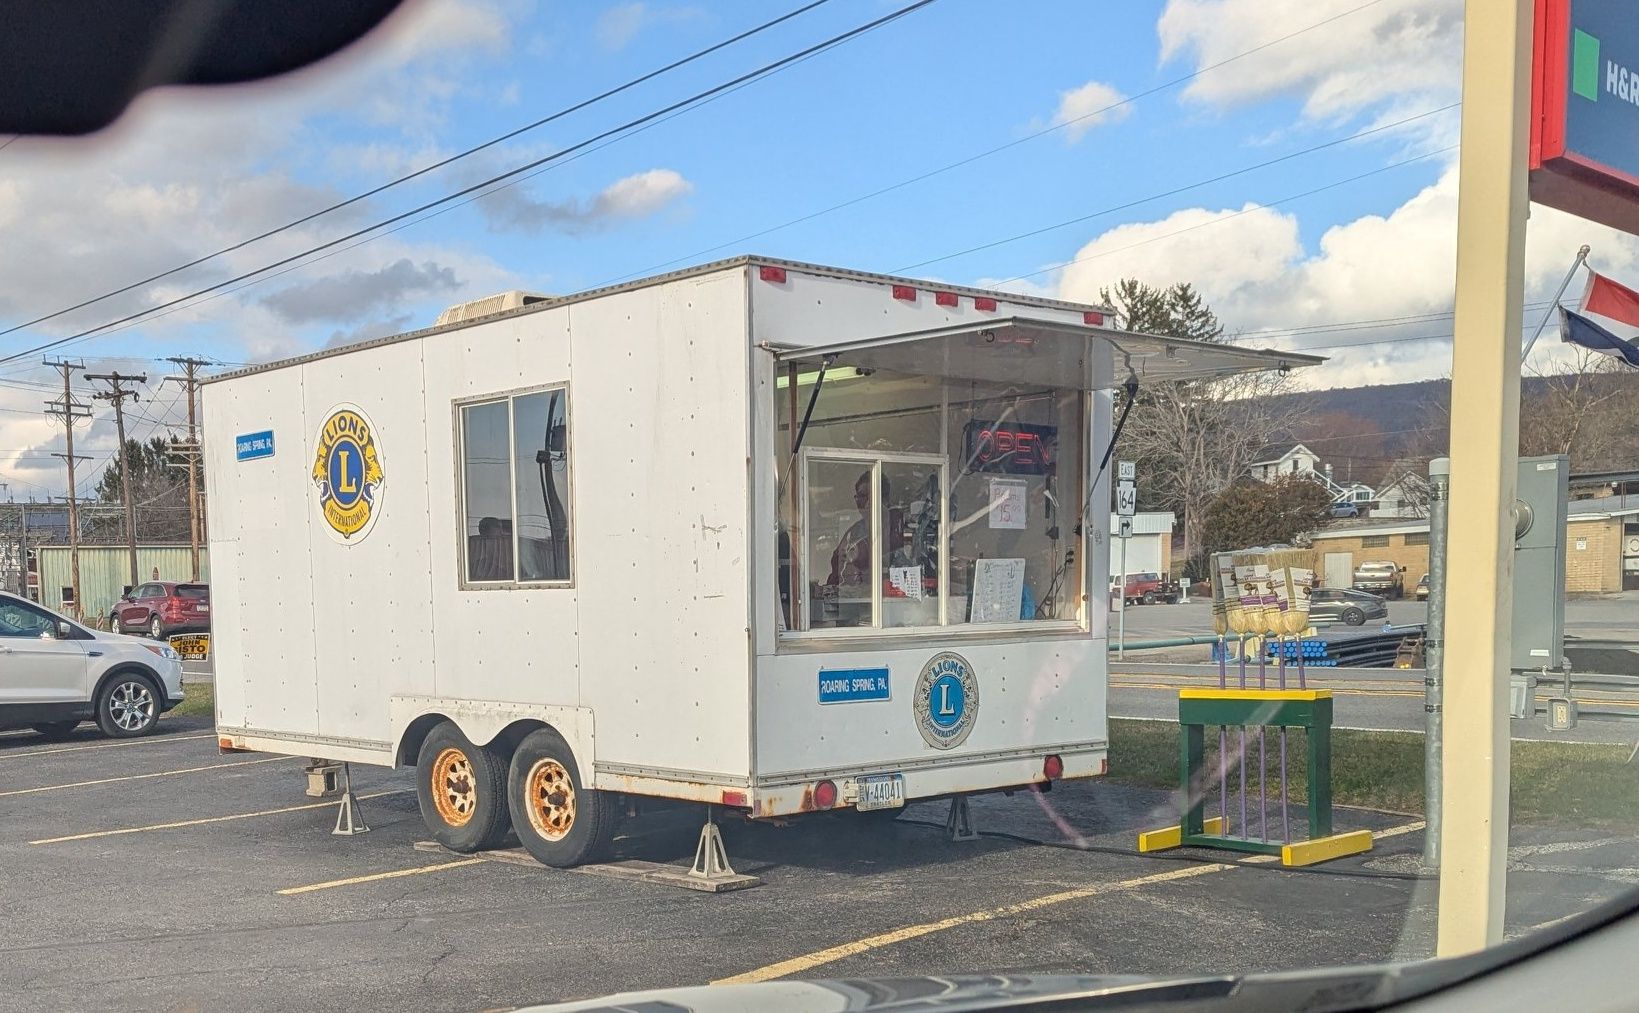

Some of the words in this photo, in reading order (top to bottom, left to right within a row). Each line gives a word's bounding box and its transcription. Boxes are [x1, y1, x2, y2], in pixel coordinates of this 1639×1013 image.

[1606, 59, 1639, 106] H&R
[325, 415, 366, 442] LIONS
[977, 430, 1051, 465] OPEN
[338, 451, 357, 493] L
[1120, 463, 1133, 476] EAST
[1119, 490, 1134, 509] 164
[328, 505, 367, 527] INTERNATIONAL
[931, 659, 965, 678] LIONS
[821, 679, 850, 694] ROARING
[939, 684, 955, 715] L
[926, 719, 965, 738] INTERNATIONAL
